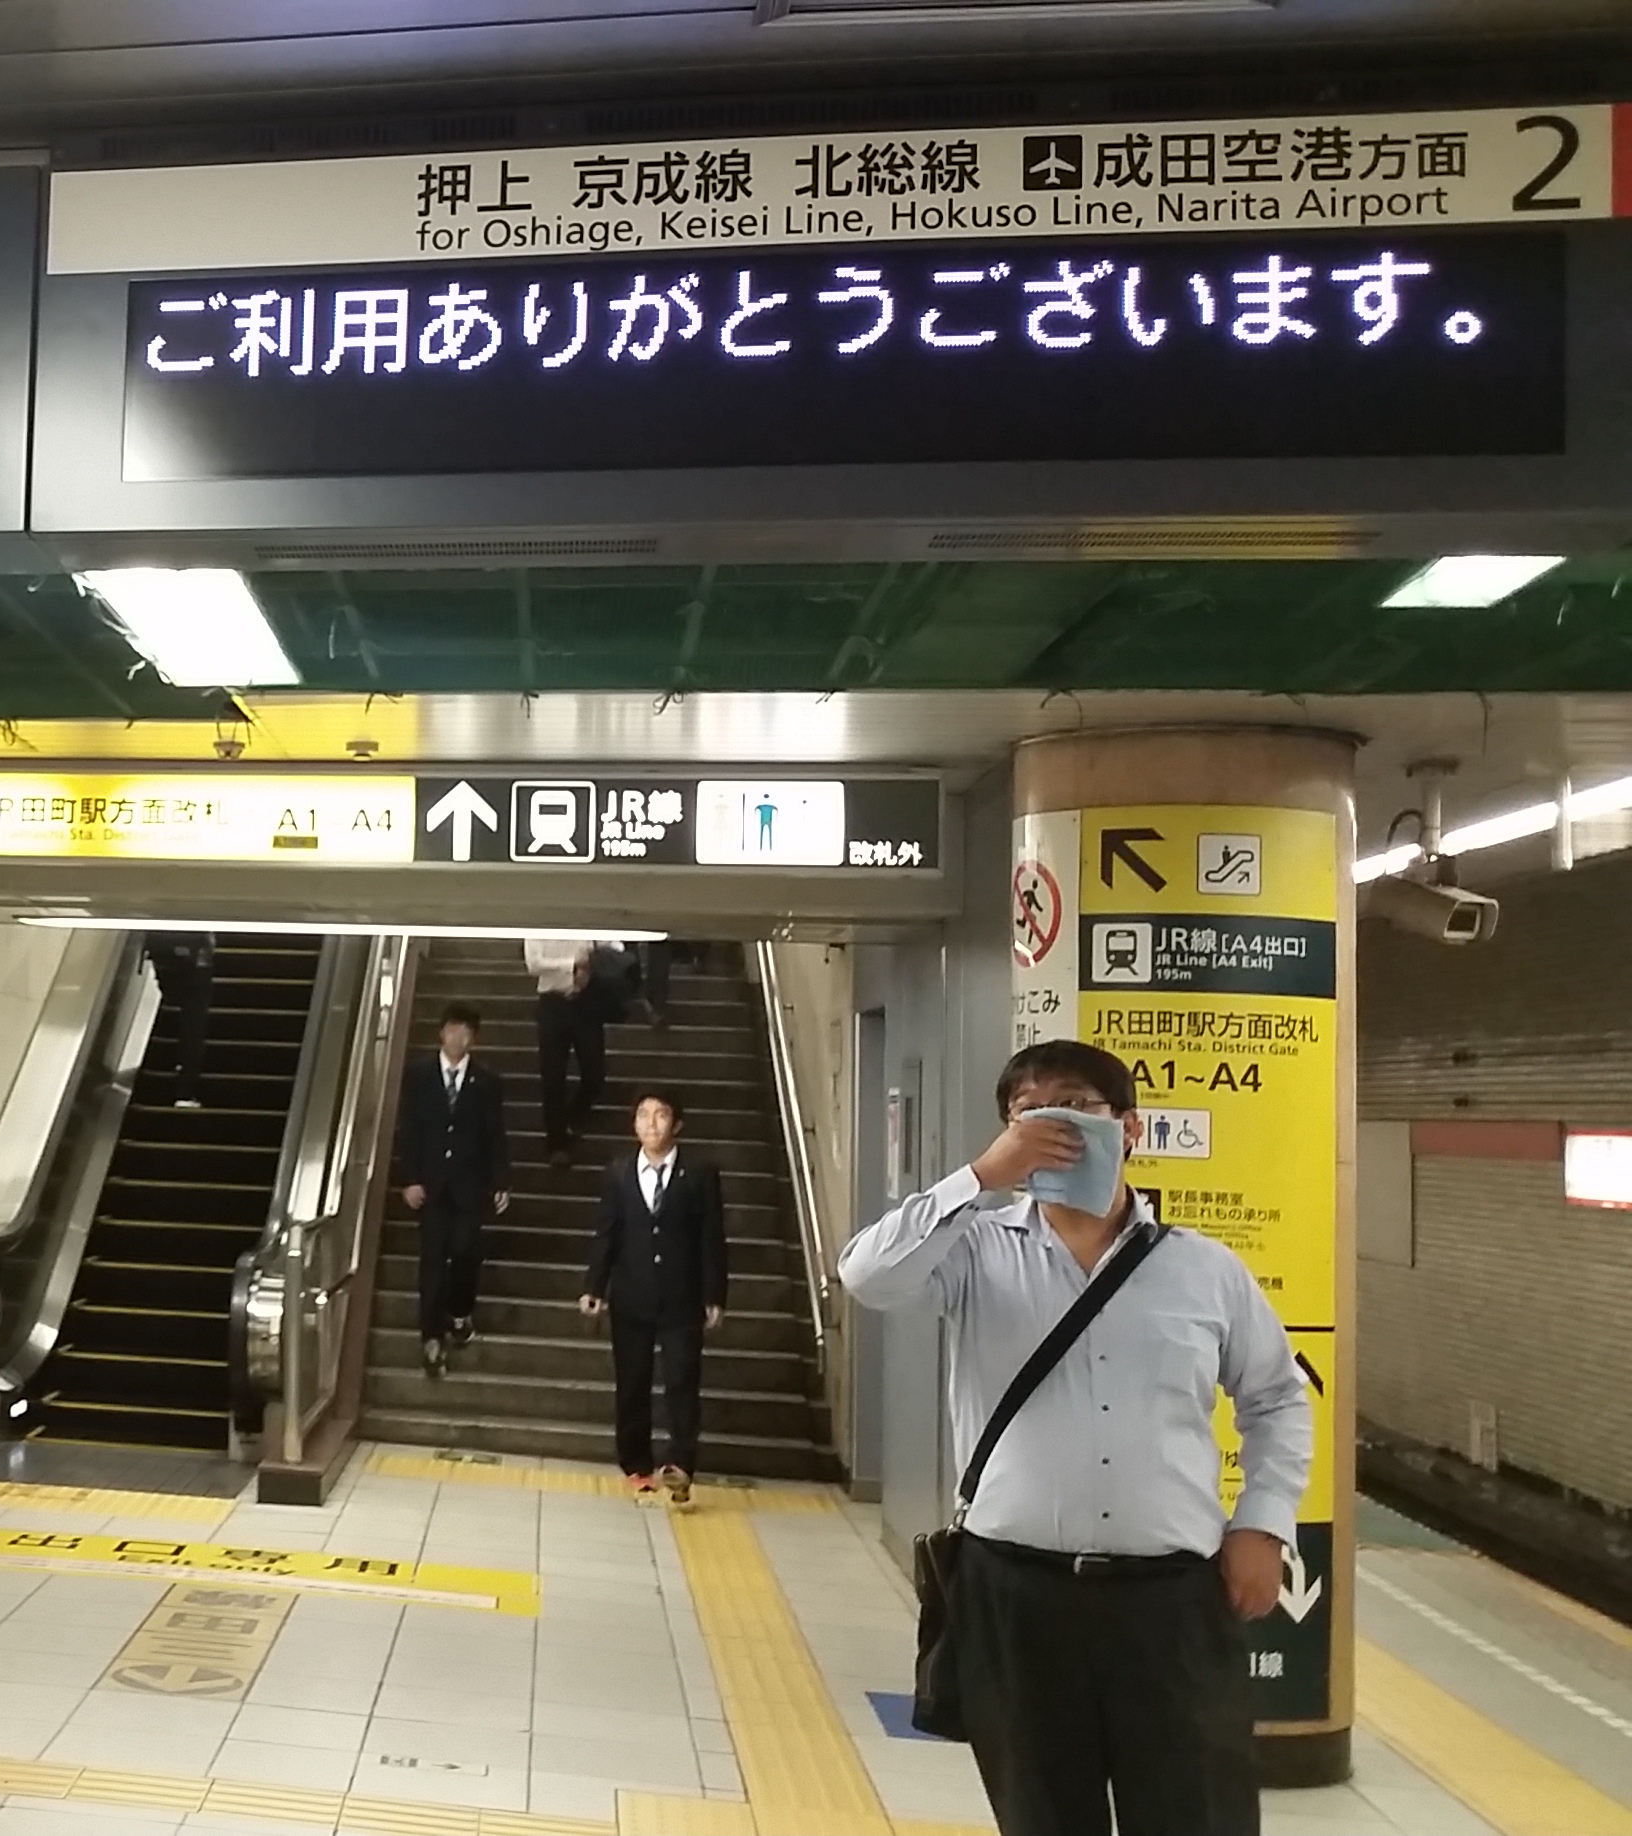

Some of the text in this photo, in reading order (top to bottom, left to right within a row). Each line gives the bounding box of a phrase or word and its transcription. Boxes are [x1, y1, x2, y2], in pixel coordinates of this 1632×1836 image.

[417, 127, 1468, 217] 押上 京成線 北総線 成田空港方面
[1511, 115, 1582, 212] 2
[416, 186, 1450, 252] for Oshiage, Keisei Line, Hokuso Line, Narita Airport
[146, 250, 1482, 376] ご利用ありがとうございます。
[600, 789, 684, 824] JR線
[625, 821, 666, 841] Line
[848, 840, 924, 866] 改札外
[1155, 953, 1172, 967] JR
[1176, 953, 1208, 967] Line
[1155, 968, 1193, 981] 195m
[1092, 1009, 1320, 1044] JR田町駅方面改札
[1112, 1038, 1173, 1051] Tamachi
[1212, 1040, 1266, 1055] District
[1269, 1043, 1300, 1057] Gate
